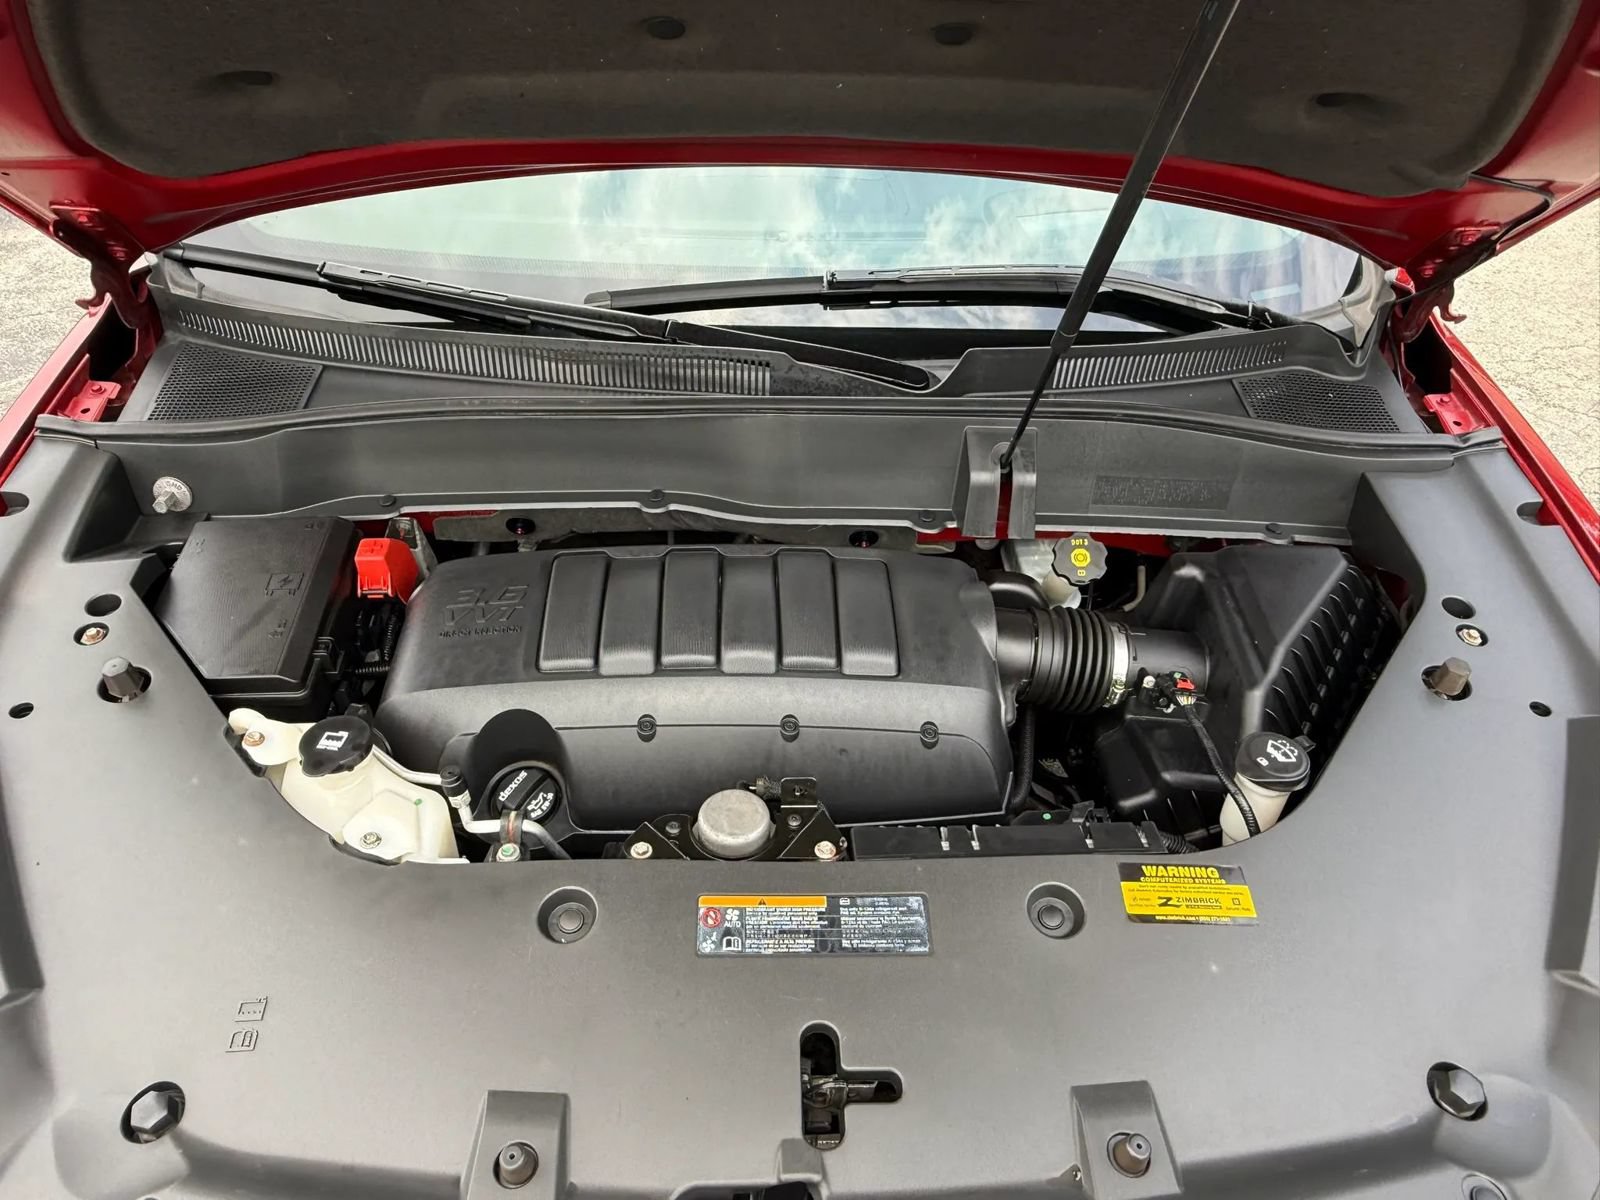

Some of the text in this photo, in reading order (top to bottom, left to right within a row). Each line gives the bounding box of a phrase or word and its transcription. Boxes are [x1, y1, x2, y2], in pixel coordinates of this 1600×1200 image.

[445, 606, 524, 626] VVT
[498, 770, 528, 802] dexos
[1141, 865, 1220, 879] WARNING
[1176, 896, 1222, 905] ZIMBRICK
